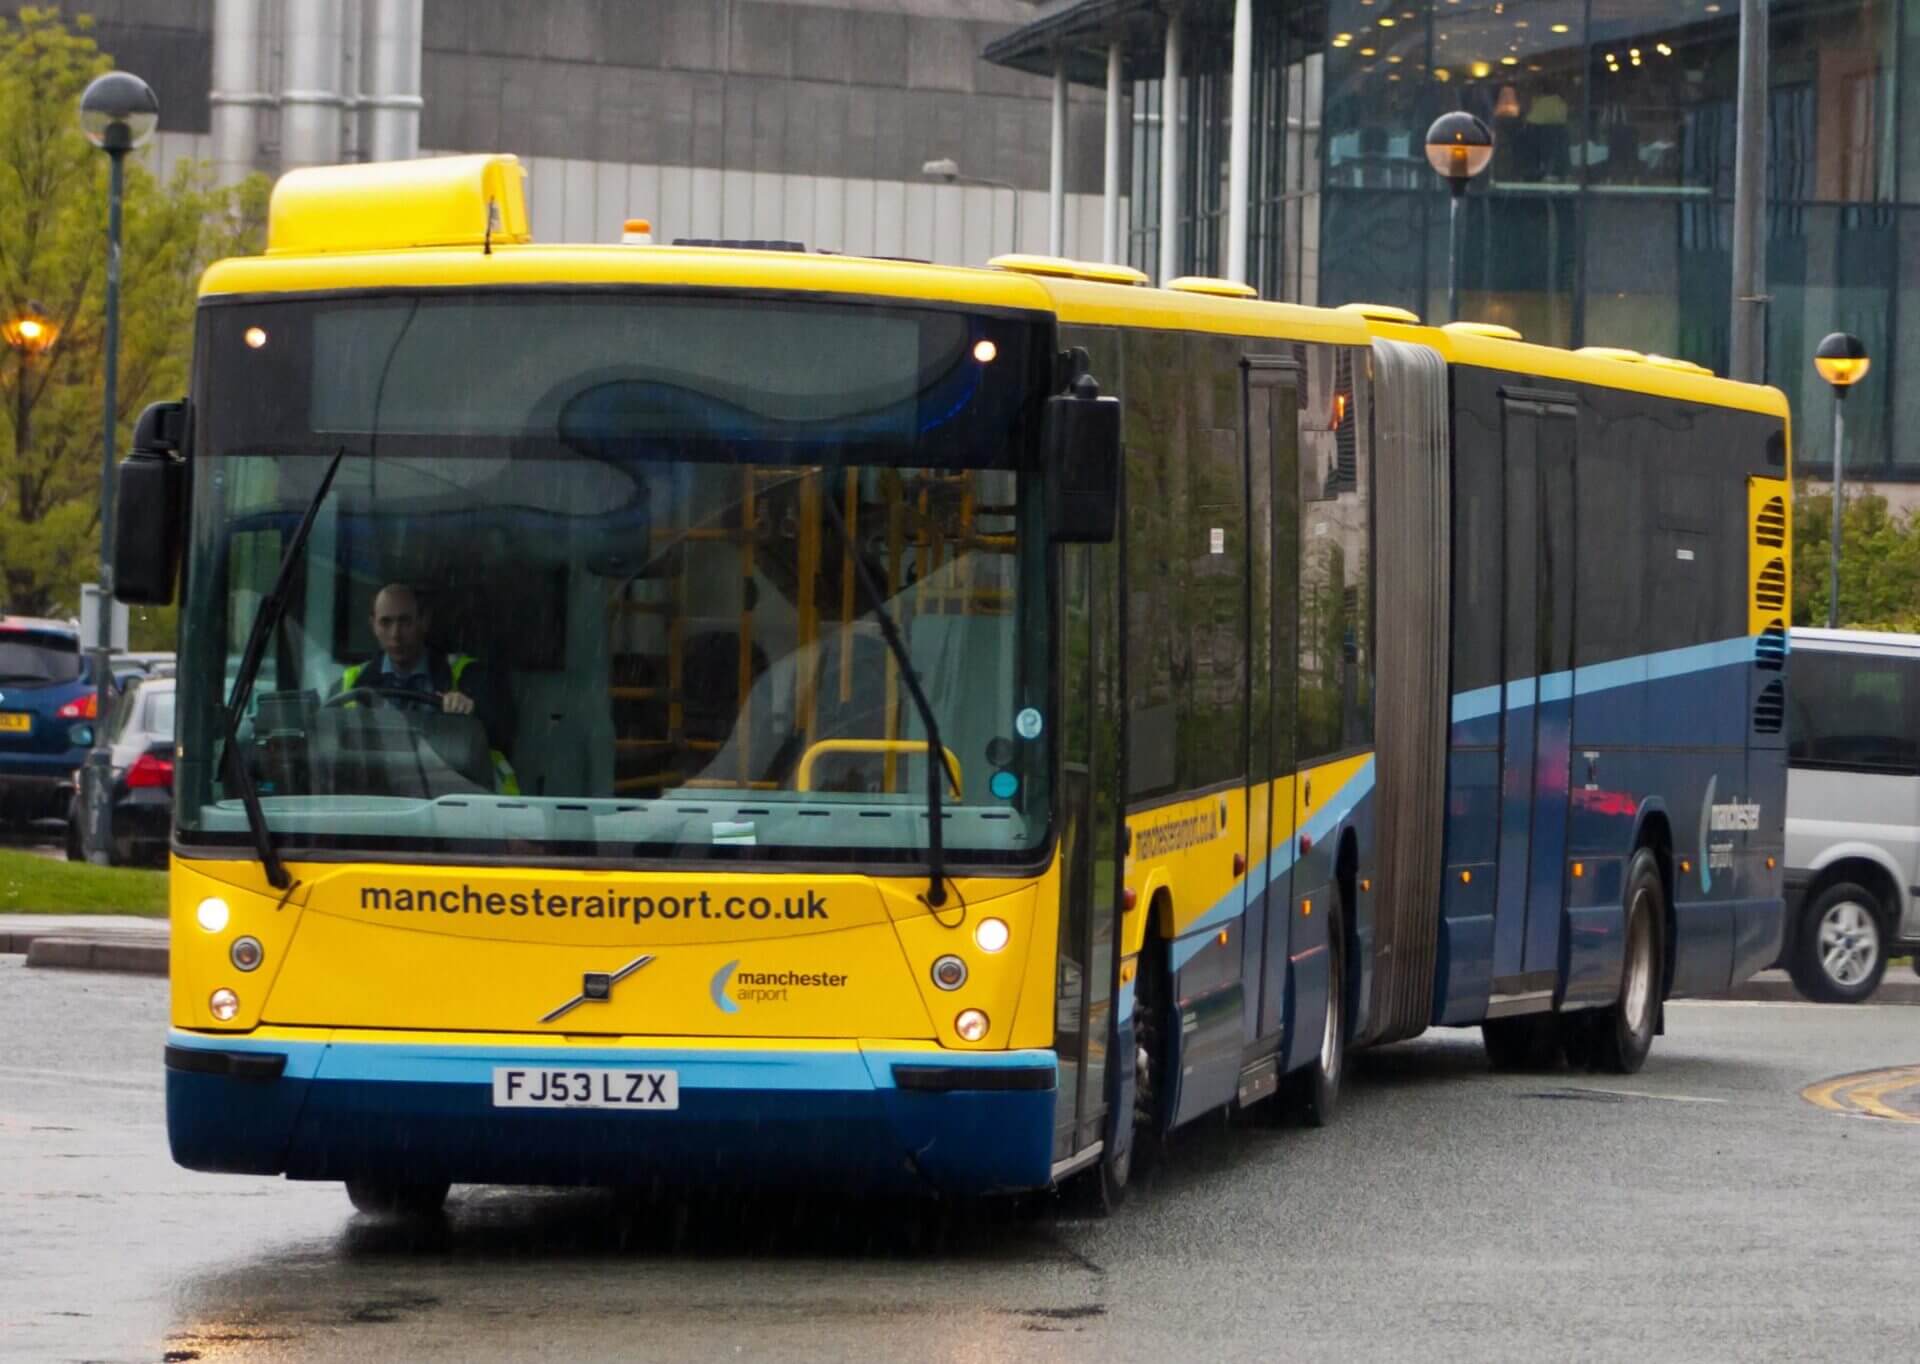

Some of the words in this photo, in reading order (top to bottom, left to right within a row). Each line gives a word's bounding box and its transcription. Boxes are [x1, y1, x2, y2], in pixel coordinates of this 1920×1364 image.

[361, 884, 829, 924] manchesterairport.co.uk
[738, 970, 848, 986] manchester
[737, 987, 788, 1003] airport
[507, 1071, 591, 1102] FJ53
[603, 1073, 666, 1103] LZX
